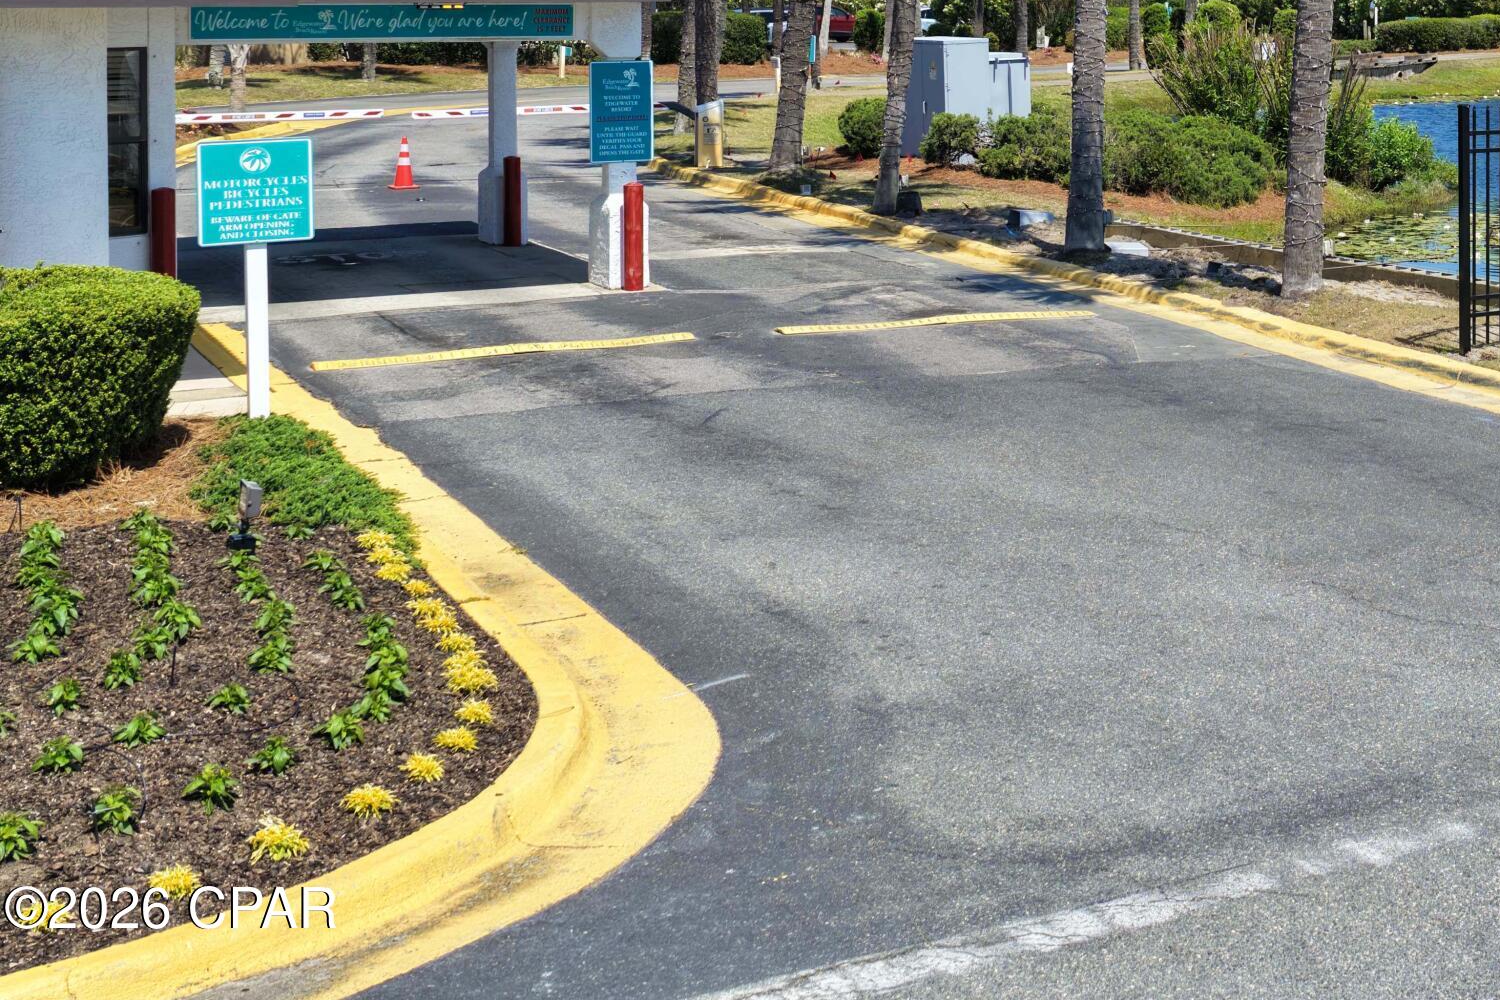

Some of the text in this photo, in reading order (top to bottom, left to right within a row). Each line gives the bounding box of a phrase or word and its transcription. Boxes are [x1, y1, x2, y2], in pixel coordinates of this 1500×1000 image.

[195, 9, 289, 31] Welcome to
[338, 9, 528, 33] We're glad you are here!
[204, 174, 308, 190] MOTORCYCLES
[223, 186, 289, 199] BICYCLES
[209, 196, 303, 211] PEDESTRIANS
[210, 211, 303, 225] BEWARE OF GATE
[218, 220, 294, 232] ARM OPENING
[219, 228, 294, 240] AND CLOSING
